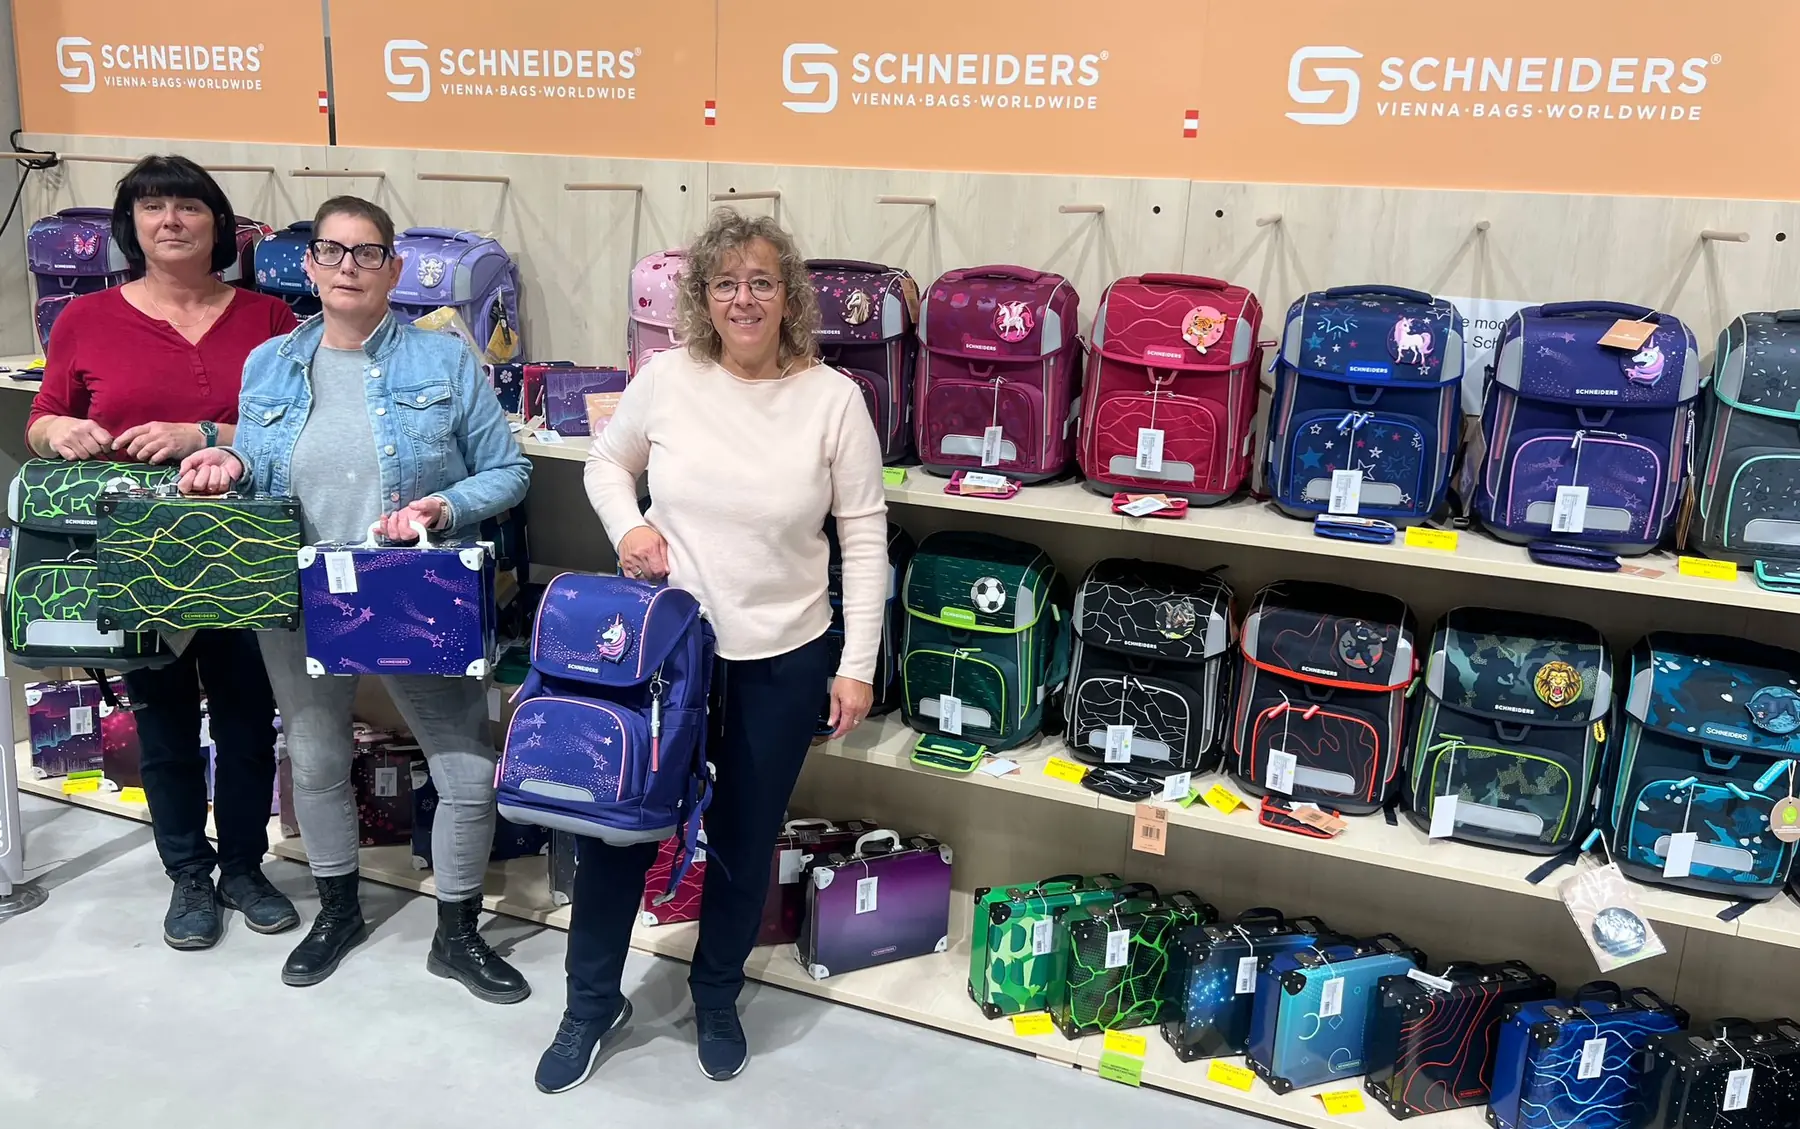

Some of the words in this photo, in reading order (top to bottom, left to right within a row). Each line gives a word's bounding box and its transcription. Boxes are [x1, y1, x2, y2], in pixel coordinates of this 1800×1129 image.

[965, 343, 997, 351] SCHNEIDERS
[1147, 350, 1182, 359] SCHNEIDERS
[1349, 366, 1388, 374] SCHNEIDERS
[1575, 388, 1618, 396] SCHNEIDERS
[1124, 640, 1158, 649] SCHNEIDERS
[567, 663, 599, 674] SCHNEIDERS
[1301, 666, 1338, 677] SCHNEIDERS
[1494, 704, 1535, 715] SCHNEIDERS
[1705, 726, 1748, 741] SCHNEIDERS
